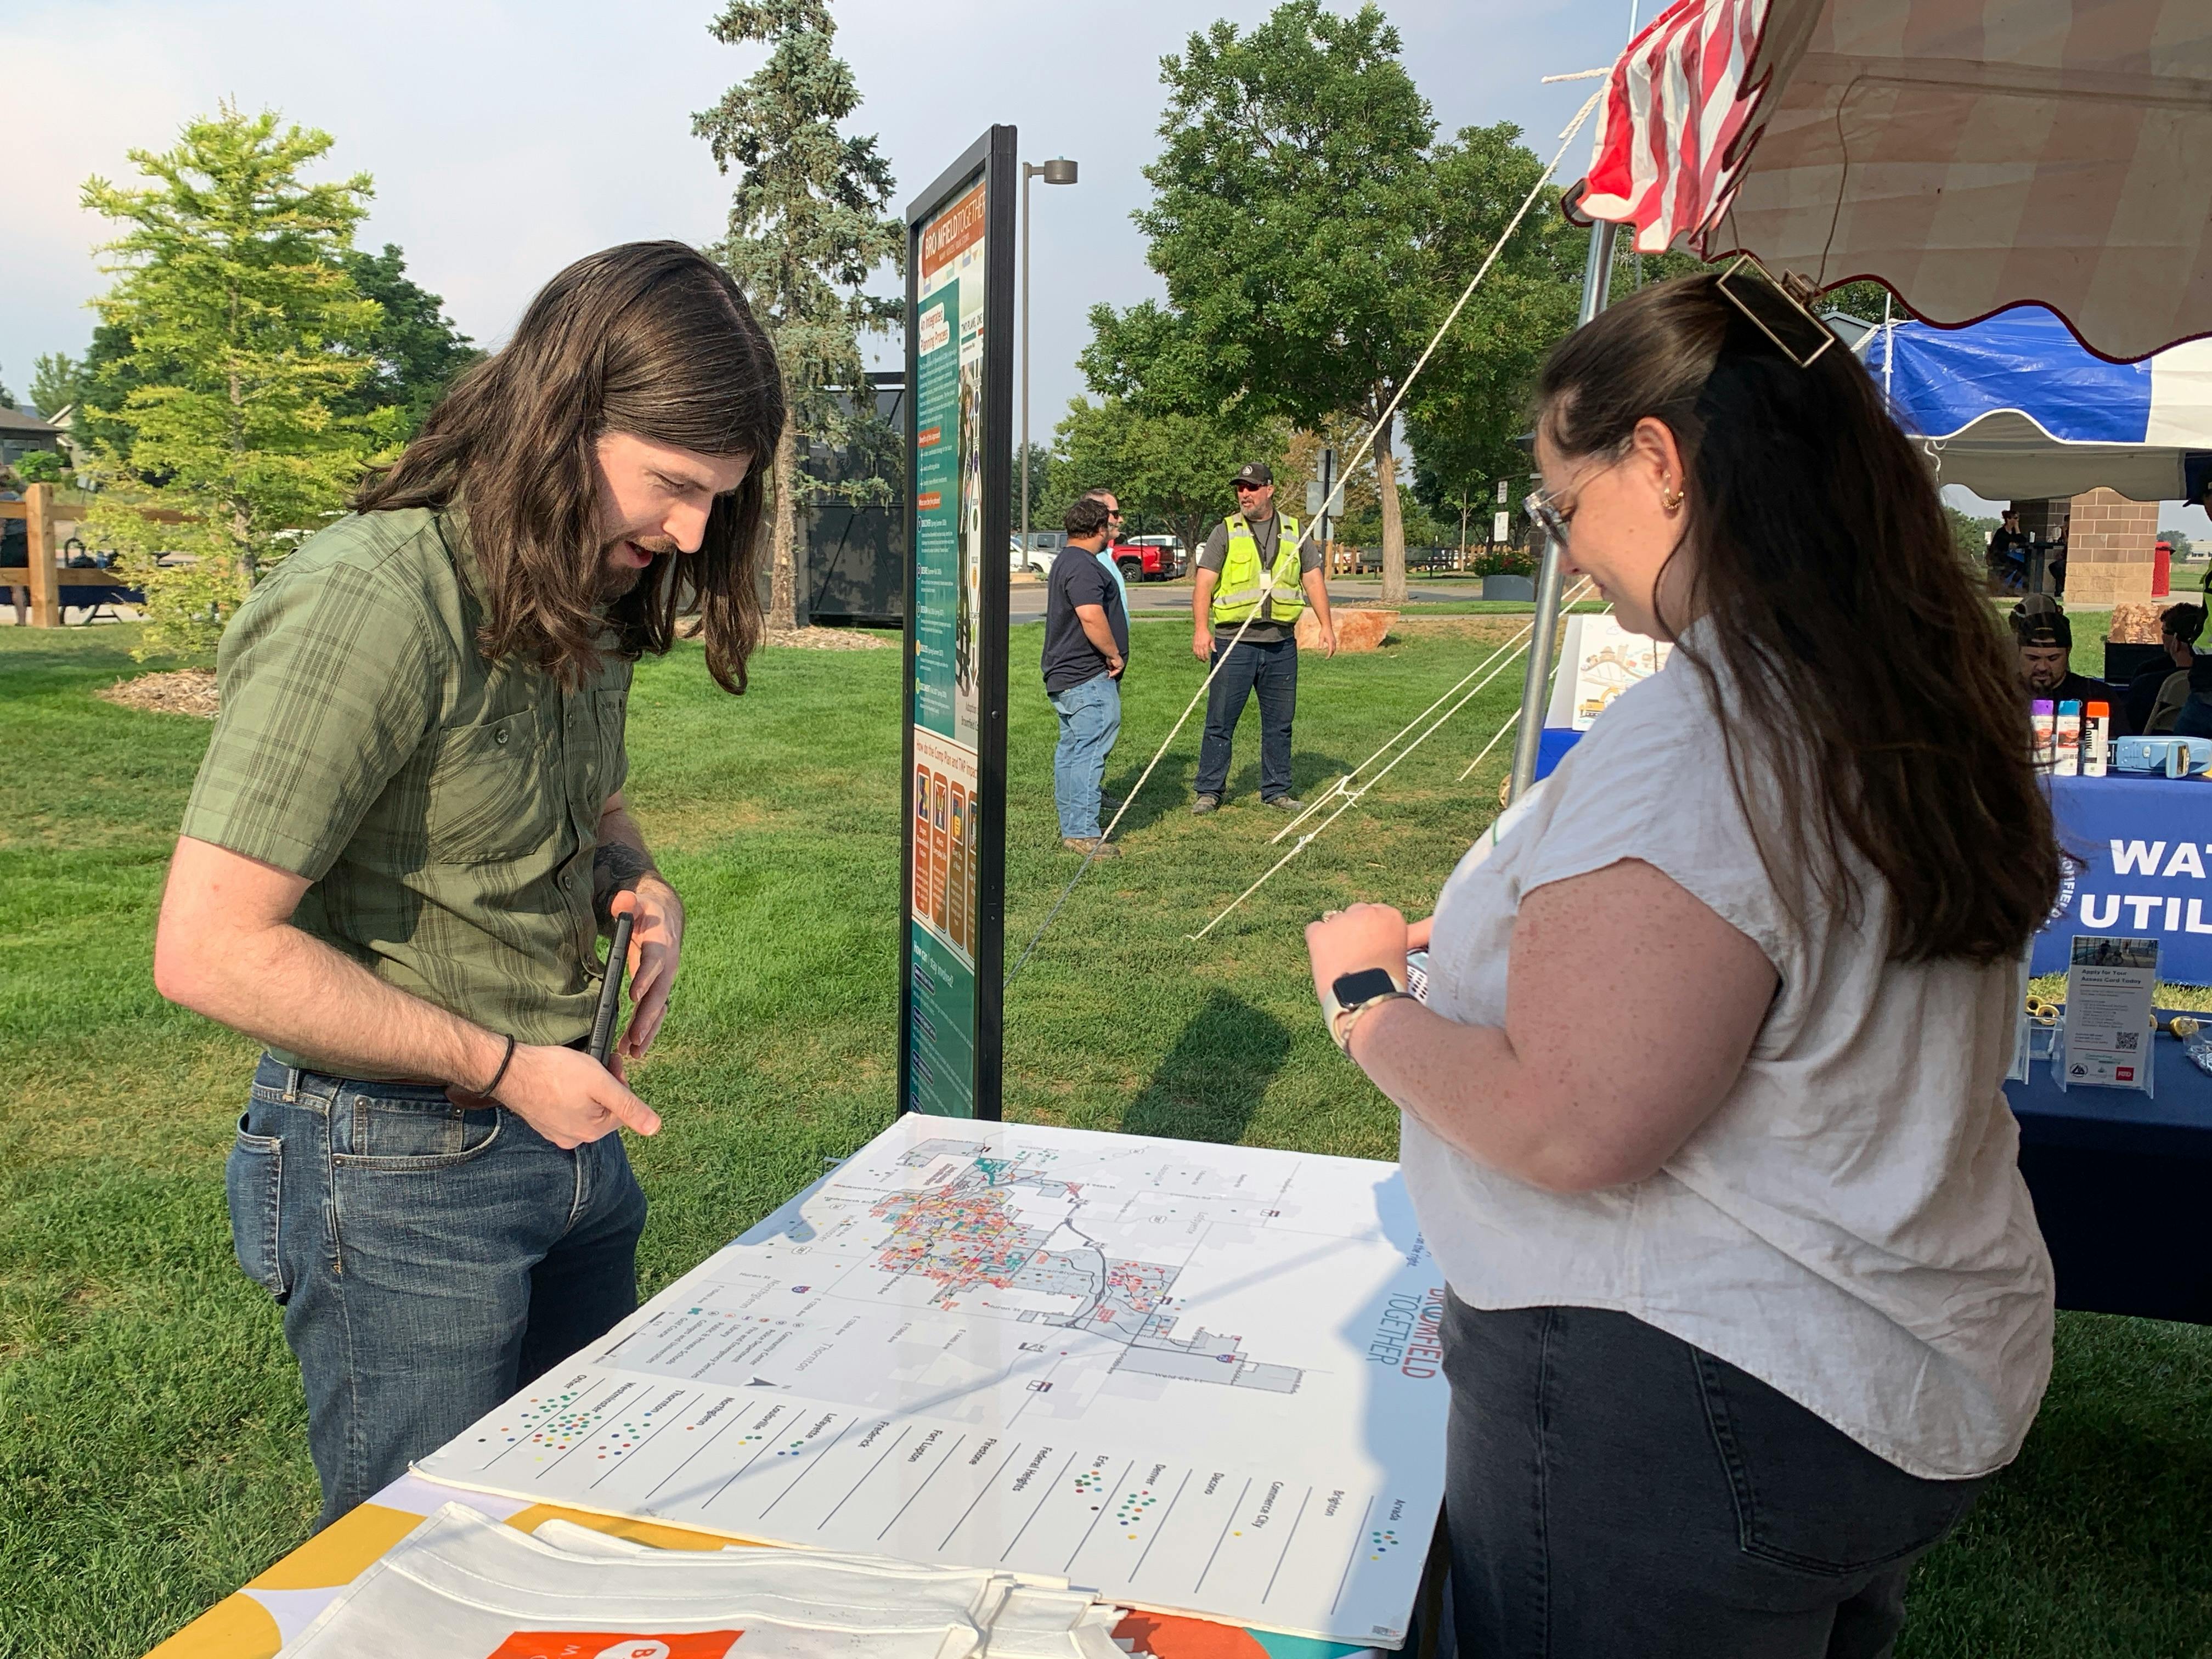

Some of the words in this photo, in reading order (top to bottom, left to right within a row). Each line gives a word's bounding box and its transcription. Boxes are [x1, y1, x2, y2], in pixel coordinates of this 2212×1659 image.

[921, 320, 926, 332] An
[926, 310, 943, 329] Integrated
[921, 335, 935, 352] Planning
[935, 329, 948, 346] Process
[924, 742, 928, 755] do
[935, 747, 944, 765] Comp
[938, 963, 954, 989] involved?
[1413, 1244, 1425, 1255] the
[735, 1279, 784, 1309] Northglenn
[654, 1325, 679, 1338] Course
[671, 1317, 689, 1325] Golf
[680, 1319, 708, 1335] Colleges
[703, 1322, 725, 1333] Public
[718, 1324, 742, 1338] Library
[1366, 1293, 1421, 1365] TOGETHER
[644, 1342, 679, 1364] Universities
[682, 1336, 706, 1350] Private
[707, 1341, 741, 1362] Emergency
[727, 1340, 763, 1363] Department
[760, 1331, 794, 1352] Community
[663, 1350, 690, 1365] Schools
[747, 1352, 770, 1365] Center
[793, 1342, 834, 1372] Thornton
[561, 1374, 589, 1389] Other
[689, 1362, 716, 1378] Services
[588, 1381, 636, 1413] Westminster
[648, 1389, 685, 1413] Thornton
[693, 1396, 735, 1426] Northglenn
[751, 1404, 786, 1430] Louisville
[802, 1413, 838, 1439] Lafayette
[856, 1421, 890, 1448] Frederick
[923, 1429, 944, 1442] Fort
[904, 1442, 933, 1463] Lupton
[966, 1437, 998, 1465] Firestone
[1026, 1446, 1053, 1469] Federal
[1091, 1455, 1109, 1468] Erie
[1008, 1468, 1037, 1492] Heights
[1143, 1463, 1166, 1486] Denver
[1203, 1472, 1225, 1496] Dacono
[1258, 1481, 1284, 1514] Commerce
[1322, 1489, 1345, 1517] Brighton
[1387, 1498, 1406, 1521] Arvada
[1250, 1514, 1271, 1529] City
